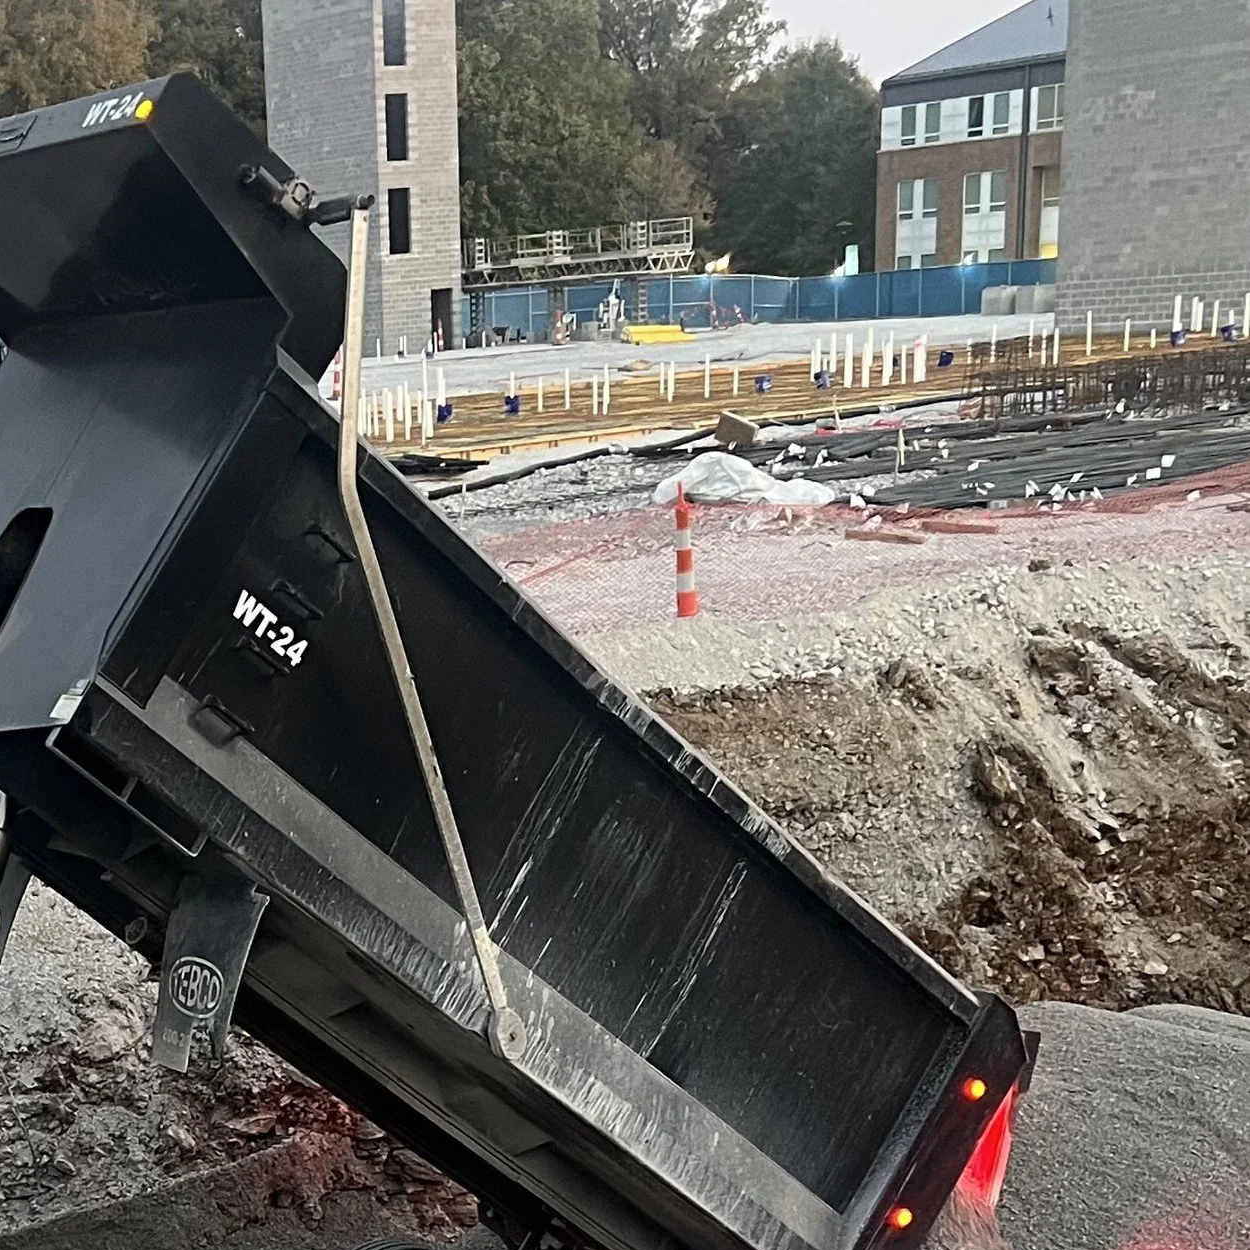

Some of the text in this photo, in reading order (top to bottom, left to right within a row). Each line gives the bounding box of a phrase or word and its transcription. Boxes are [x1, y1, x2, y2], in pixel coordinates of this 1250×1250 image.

[81, 91, 145, 128] WT-24
[232, 588, 308, 667] WT-24
[172, 964, 220, 1011] TEBCO
